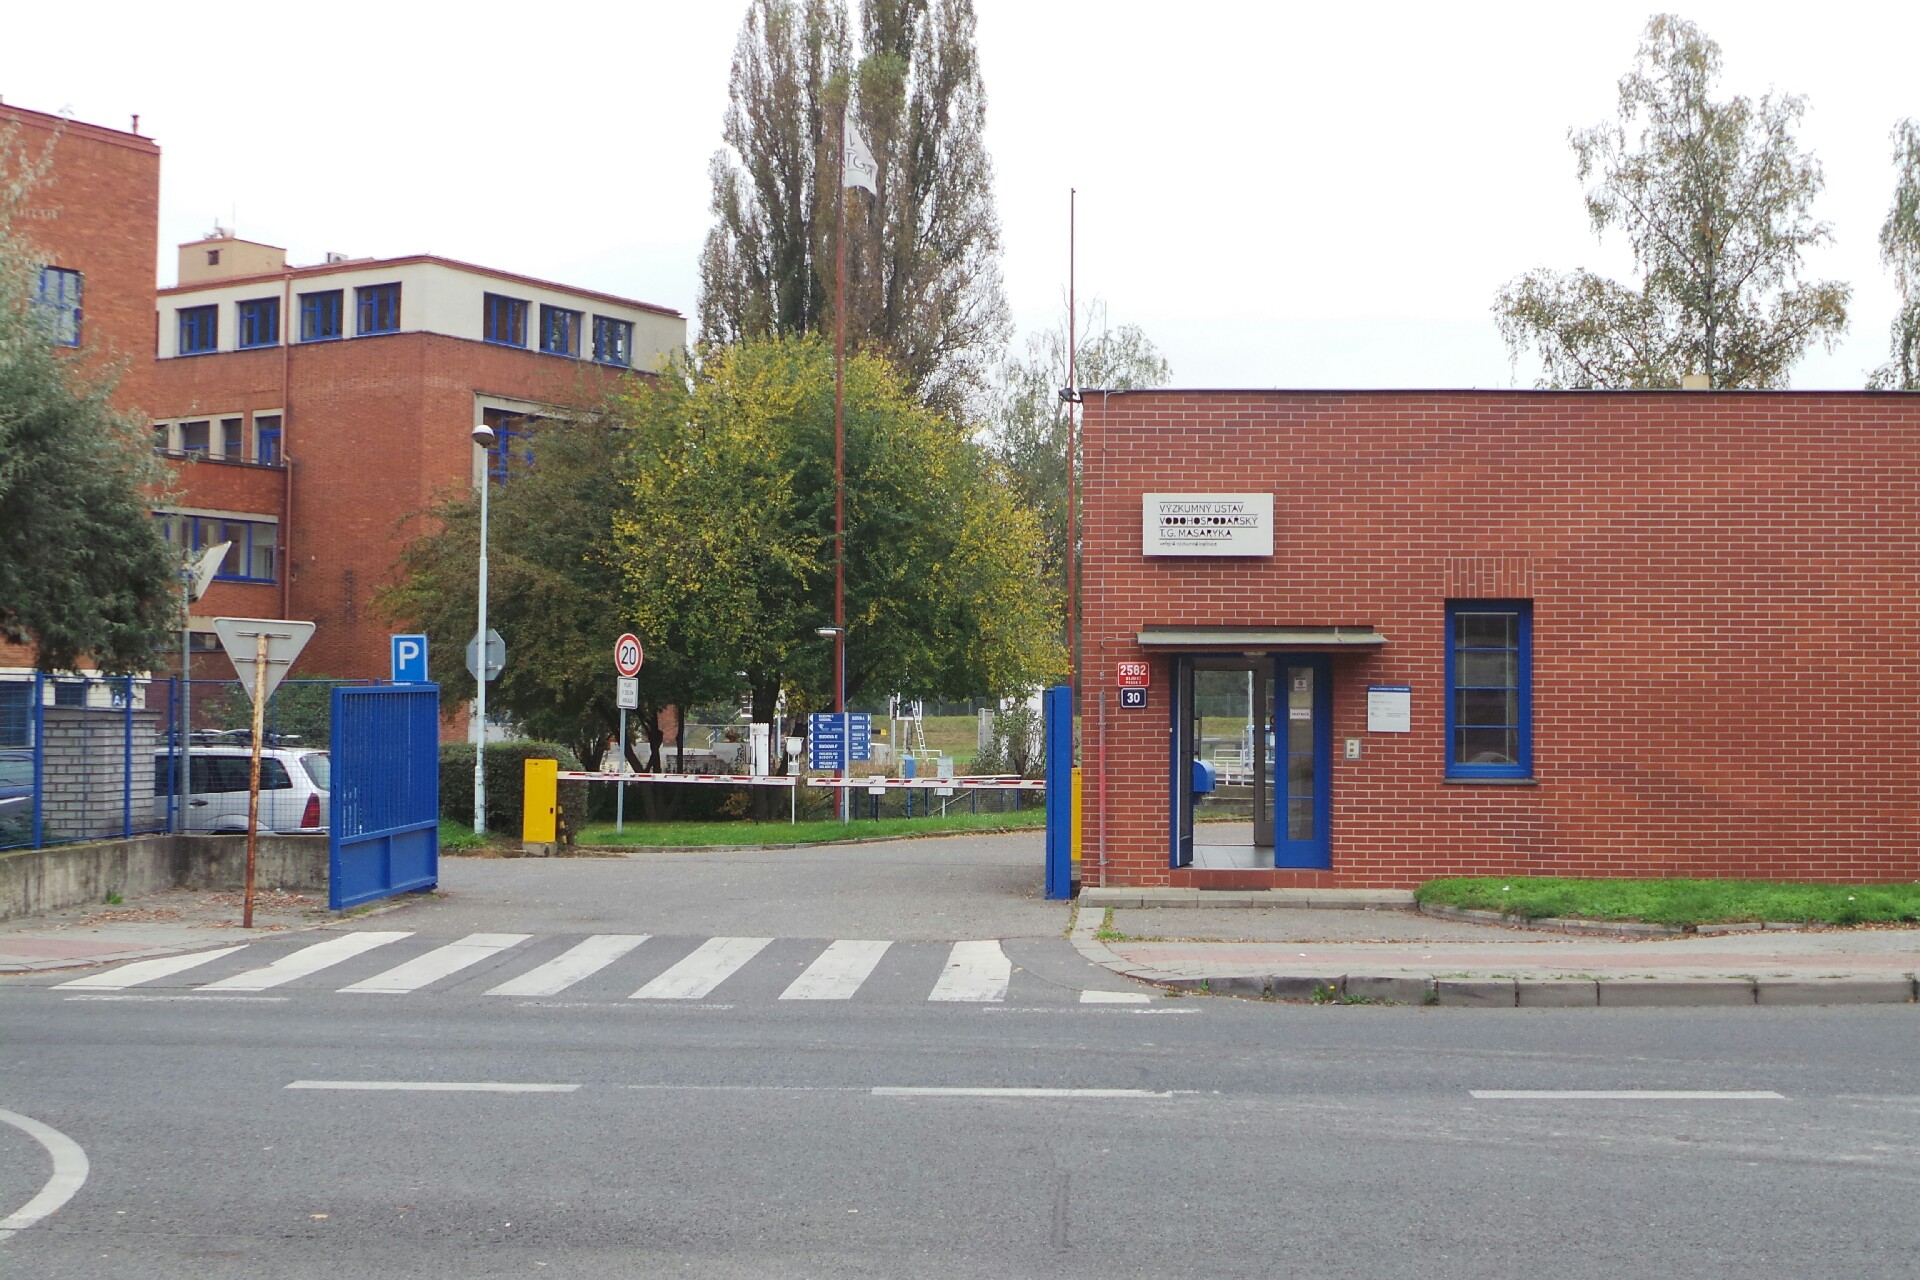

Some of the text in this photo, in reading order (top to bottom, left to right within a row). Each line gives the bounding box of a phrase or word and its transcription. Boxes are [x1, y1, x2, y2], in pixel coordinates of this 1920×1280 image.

[1159, 503, 1244, 513] VÝZKUMNÝ ÚSTAV
[1159, 515, 1258, 525] VODOHOSPODÁŘSKÝ
[1178, 528, 1233, 538] MASARYKA
[399, 641, 419, 670] P
[621, 645, 637, 665] 20
[1120, 664, 1146, 676] 2582
[1127, 692, 1140, 704] 30
